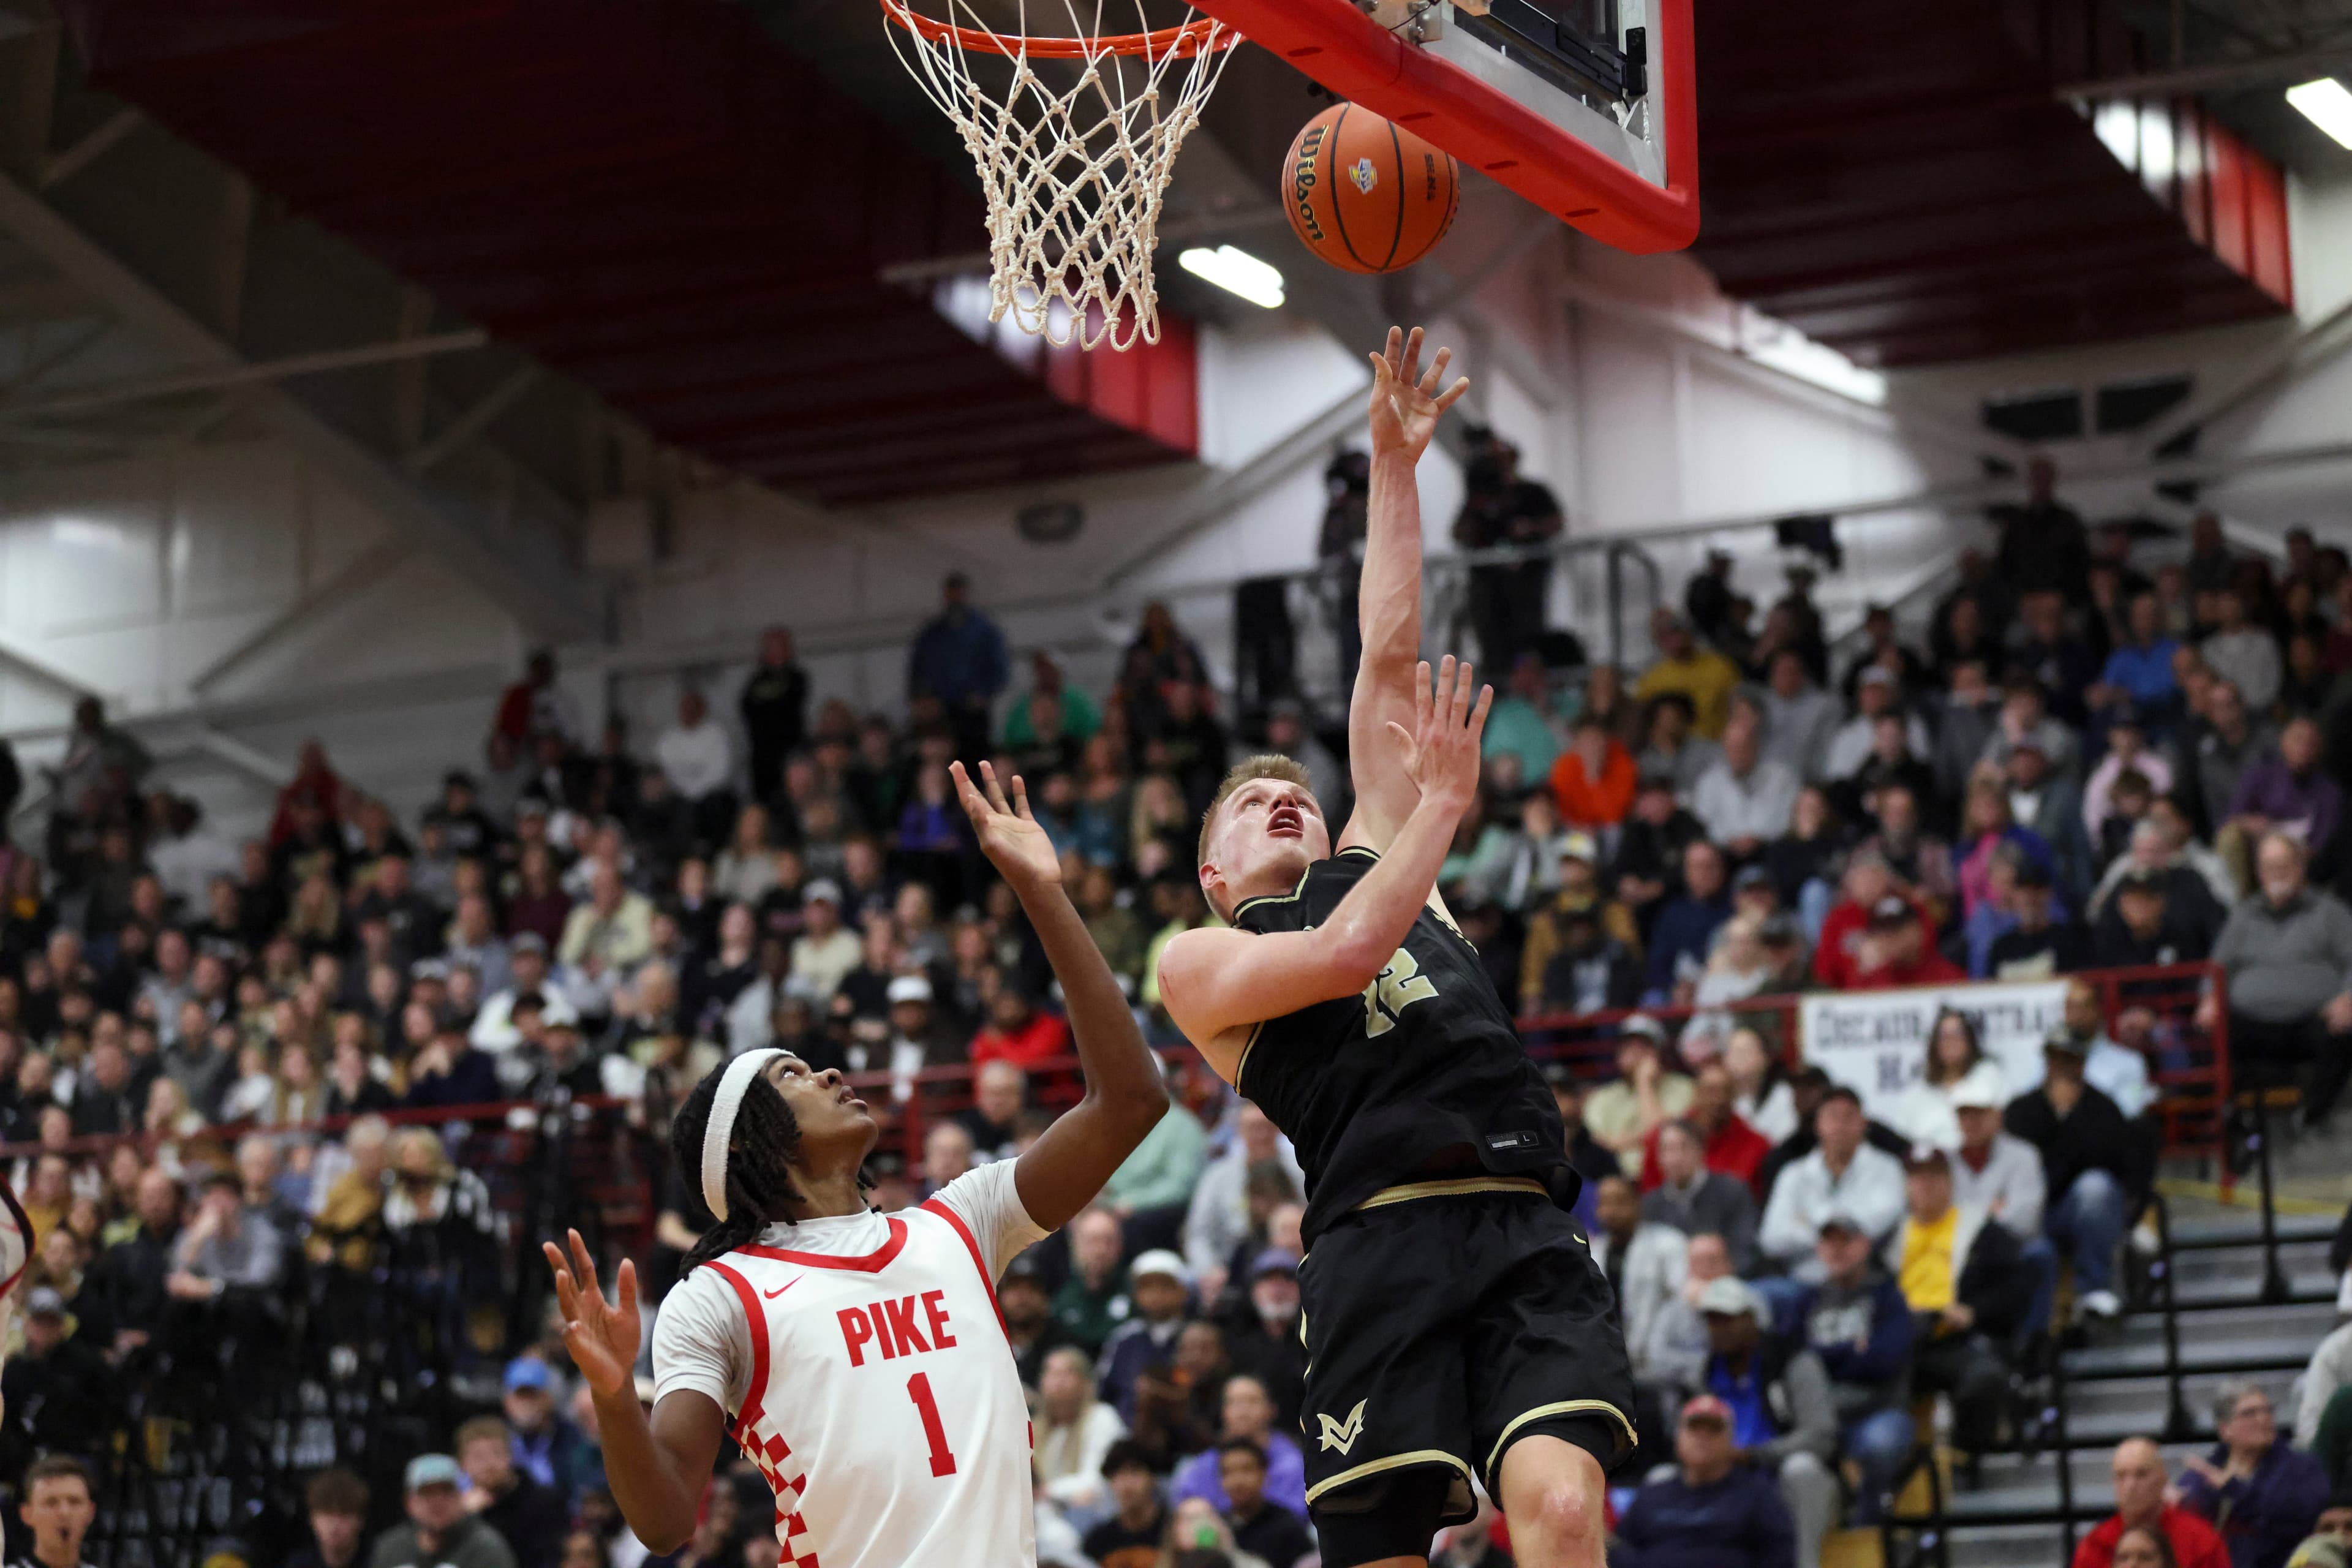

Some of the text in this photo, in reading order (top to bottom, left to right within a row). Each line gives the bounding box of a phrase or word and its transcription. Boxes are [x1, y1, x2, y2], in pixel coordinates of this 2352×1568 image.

[1295, 123, 1329, 241] Wilson
[836, 1289, 957, 1368] PIKE
[907, 1372, 957, 1478] 1
